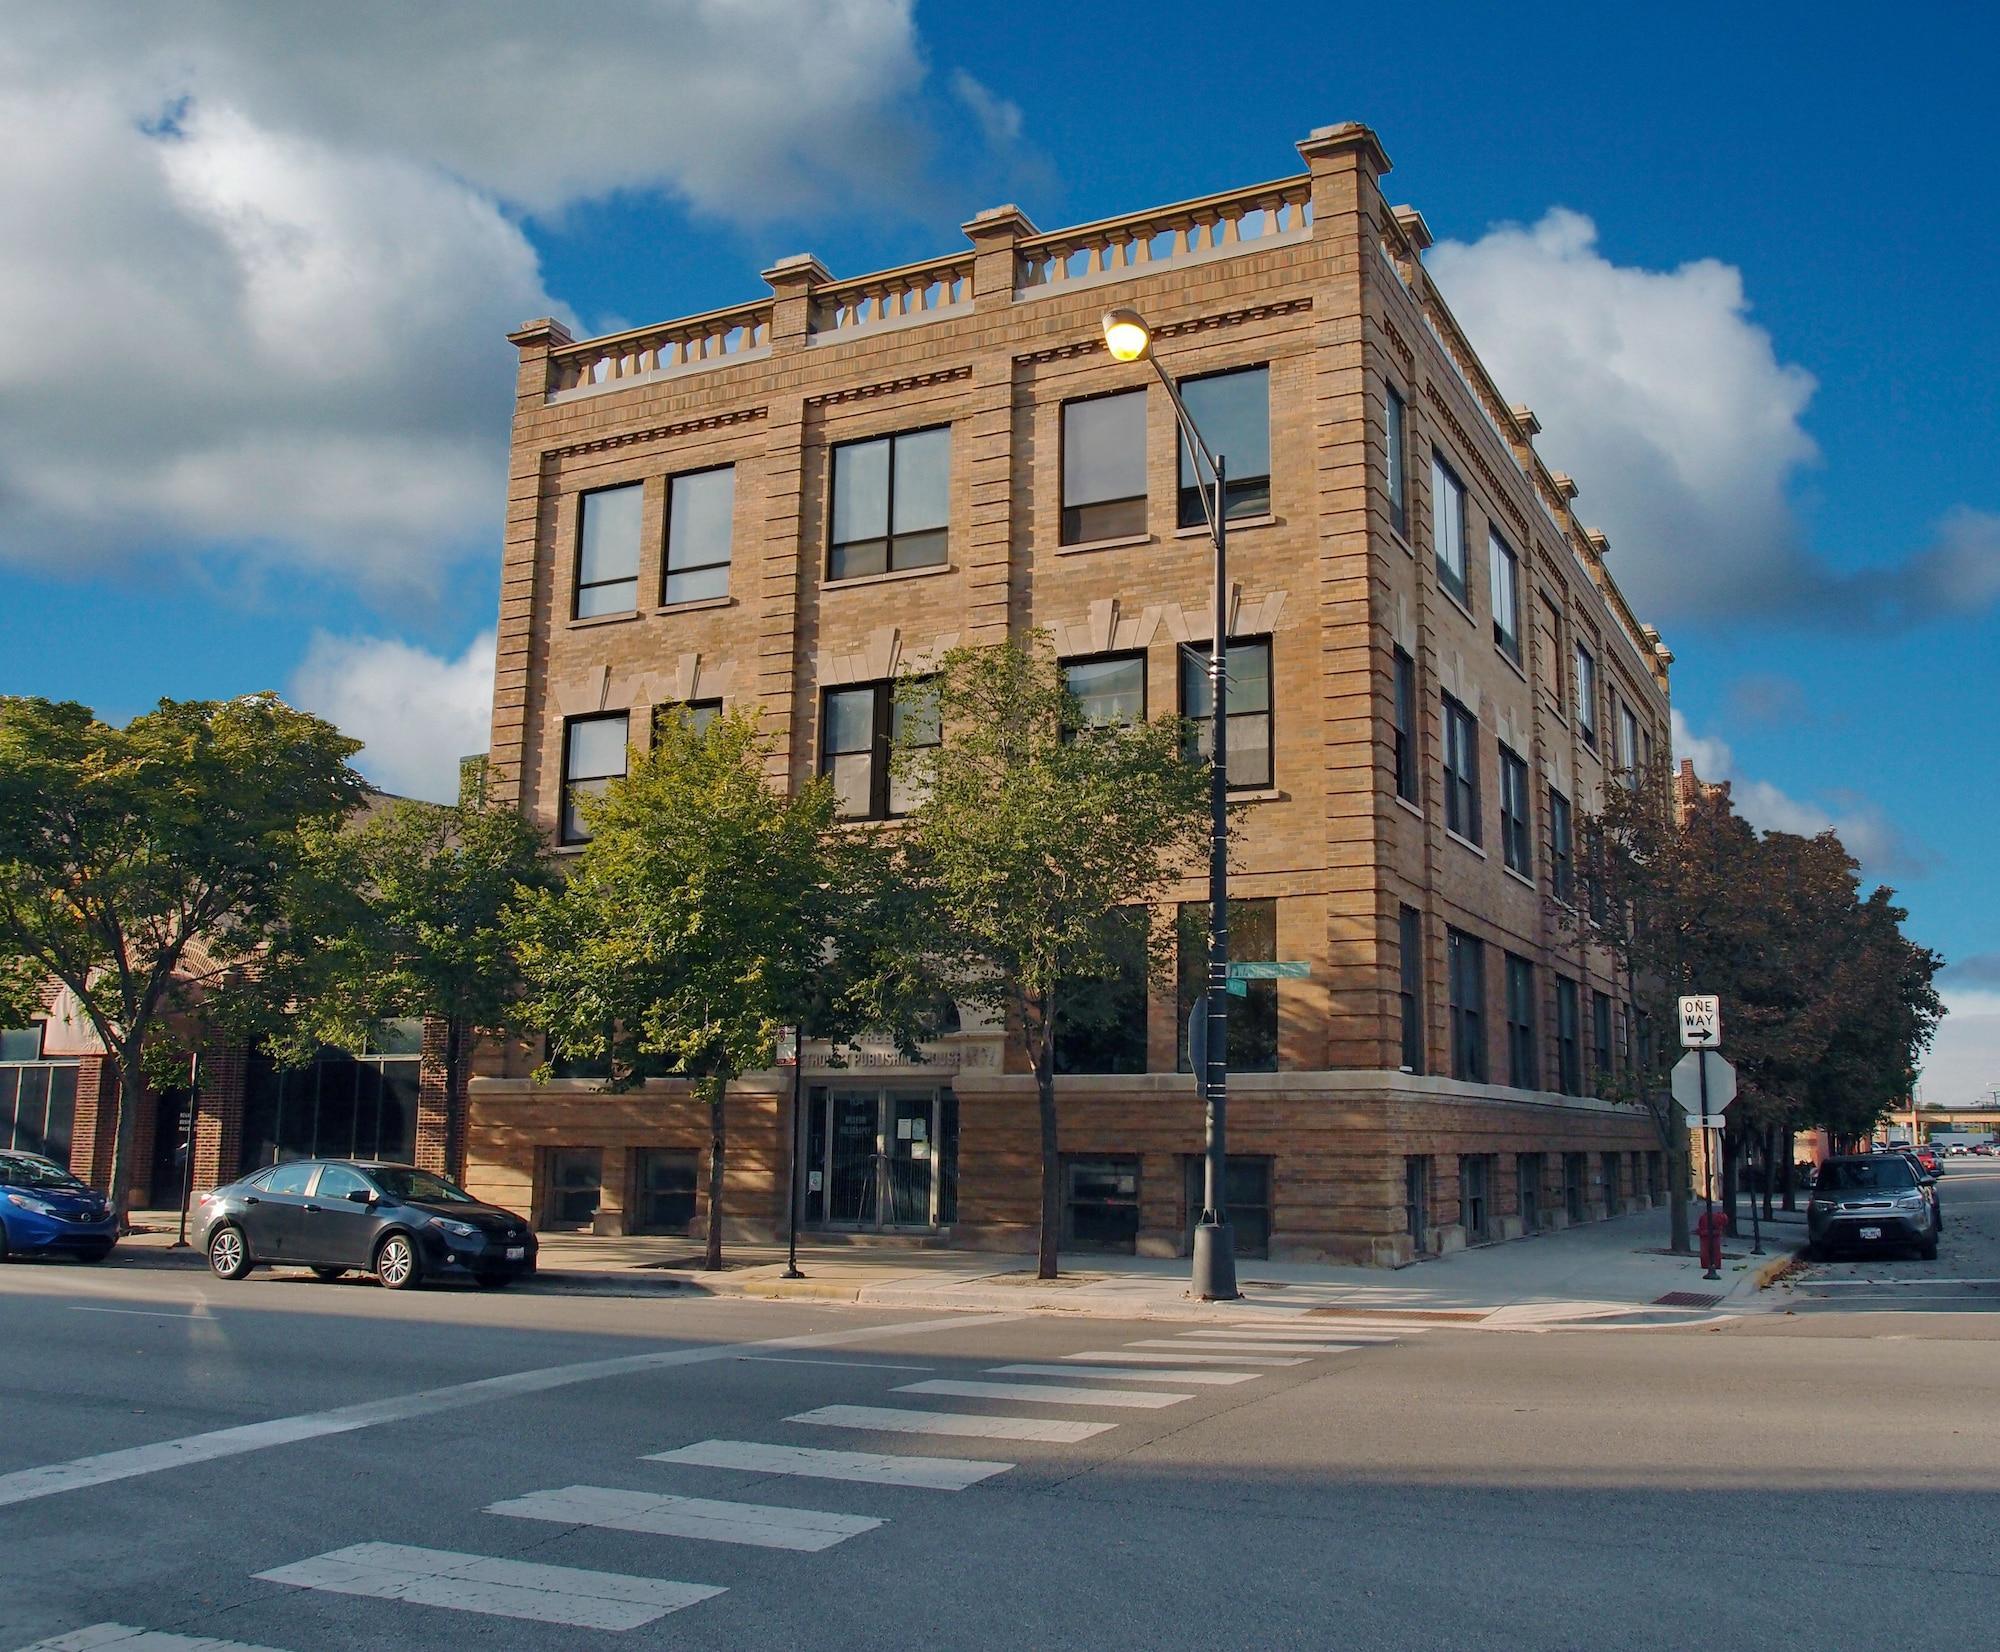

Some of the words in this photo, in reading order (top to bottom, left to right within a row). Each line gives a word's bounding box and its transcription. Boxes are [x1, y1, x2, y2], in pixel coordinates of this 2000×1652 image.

[1685, 1000, 1713, 1013] ONE
[1685, 1014, 1714, 1026] WAY
[854, 1053, 919, 1068] PUBLISHIN
